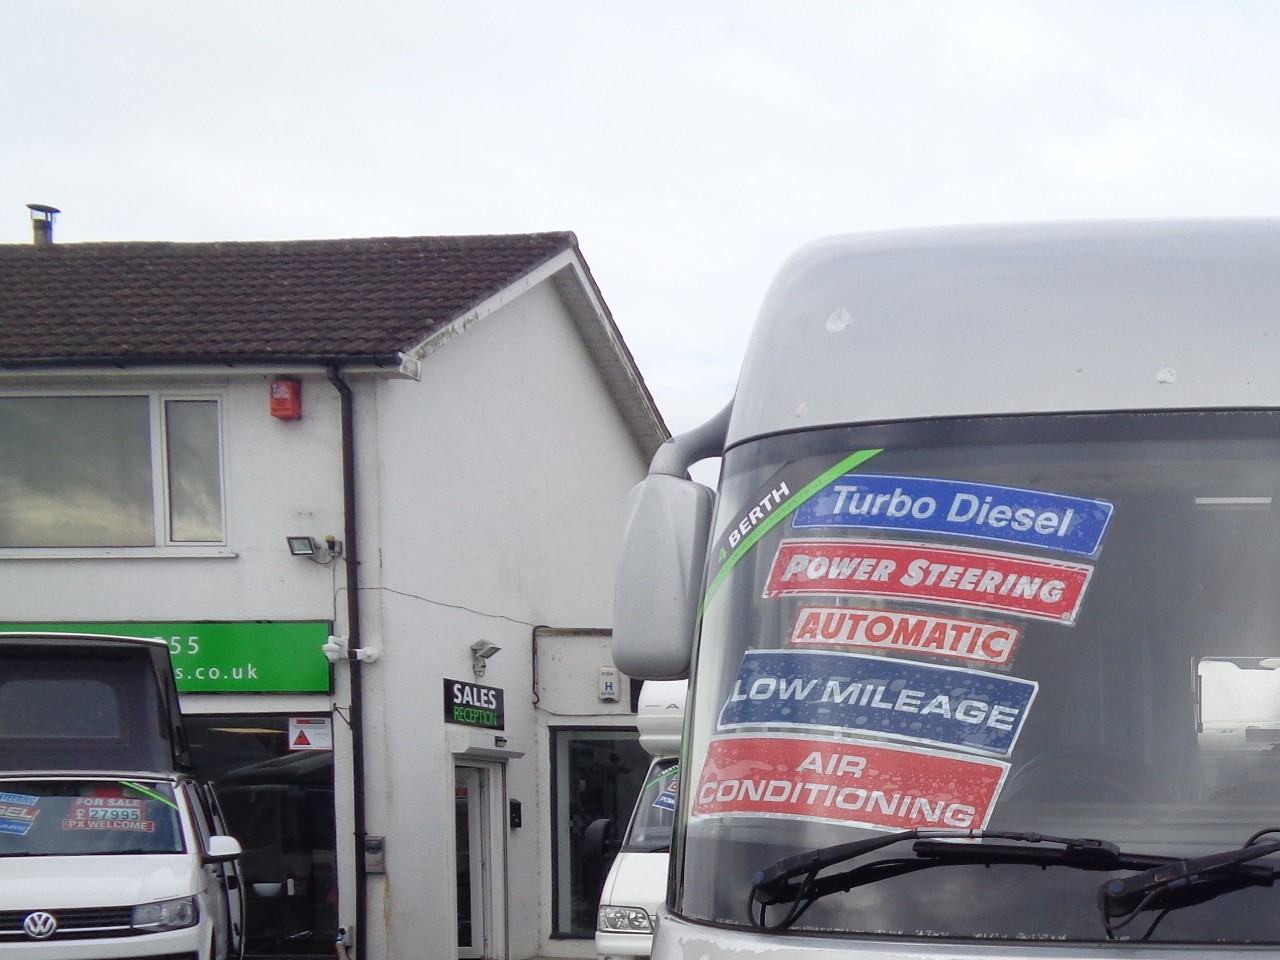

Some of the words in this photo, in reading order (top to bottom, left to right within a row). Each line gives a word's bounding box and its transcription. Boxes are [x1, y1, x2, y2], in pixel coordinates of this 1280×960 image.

[718, 547, 727, 563] 4
[728, 481, 790, 548] BERTH
[832, 485, 936, 520] Turbo
[947, 494, 1074, 537] Diesel
[784, 554, 896, 583] POWER
[901, 558, 1066, 603] STEERING
[798, 612, 1012, 659] AUTOMATIC
[453, 683, 496, 709] SALES
[731, 677, 816, 702] LOW
[819, 680, 1020, 730] MILEAGE
[454, 706, 496, 725] RECEPTION
[796, 752, 866, 778] AIR
[76, 799, 104, 807] FOR
[107, 799, 141, 808] SALE
[90, 809, 139, 820] 27995
[700, 780, 975, 829] CONDITIONING
[87, 821, 147, 830] WELCOME
